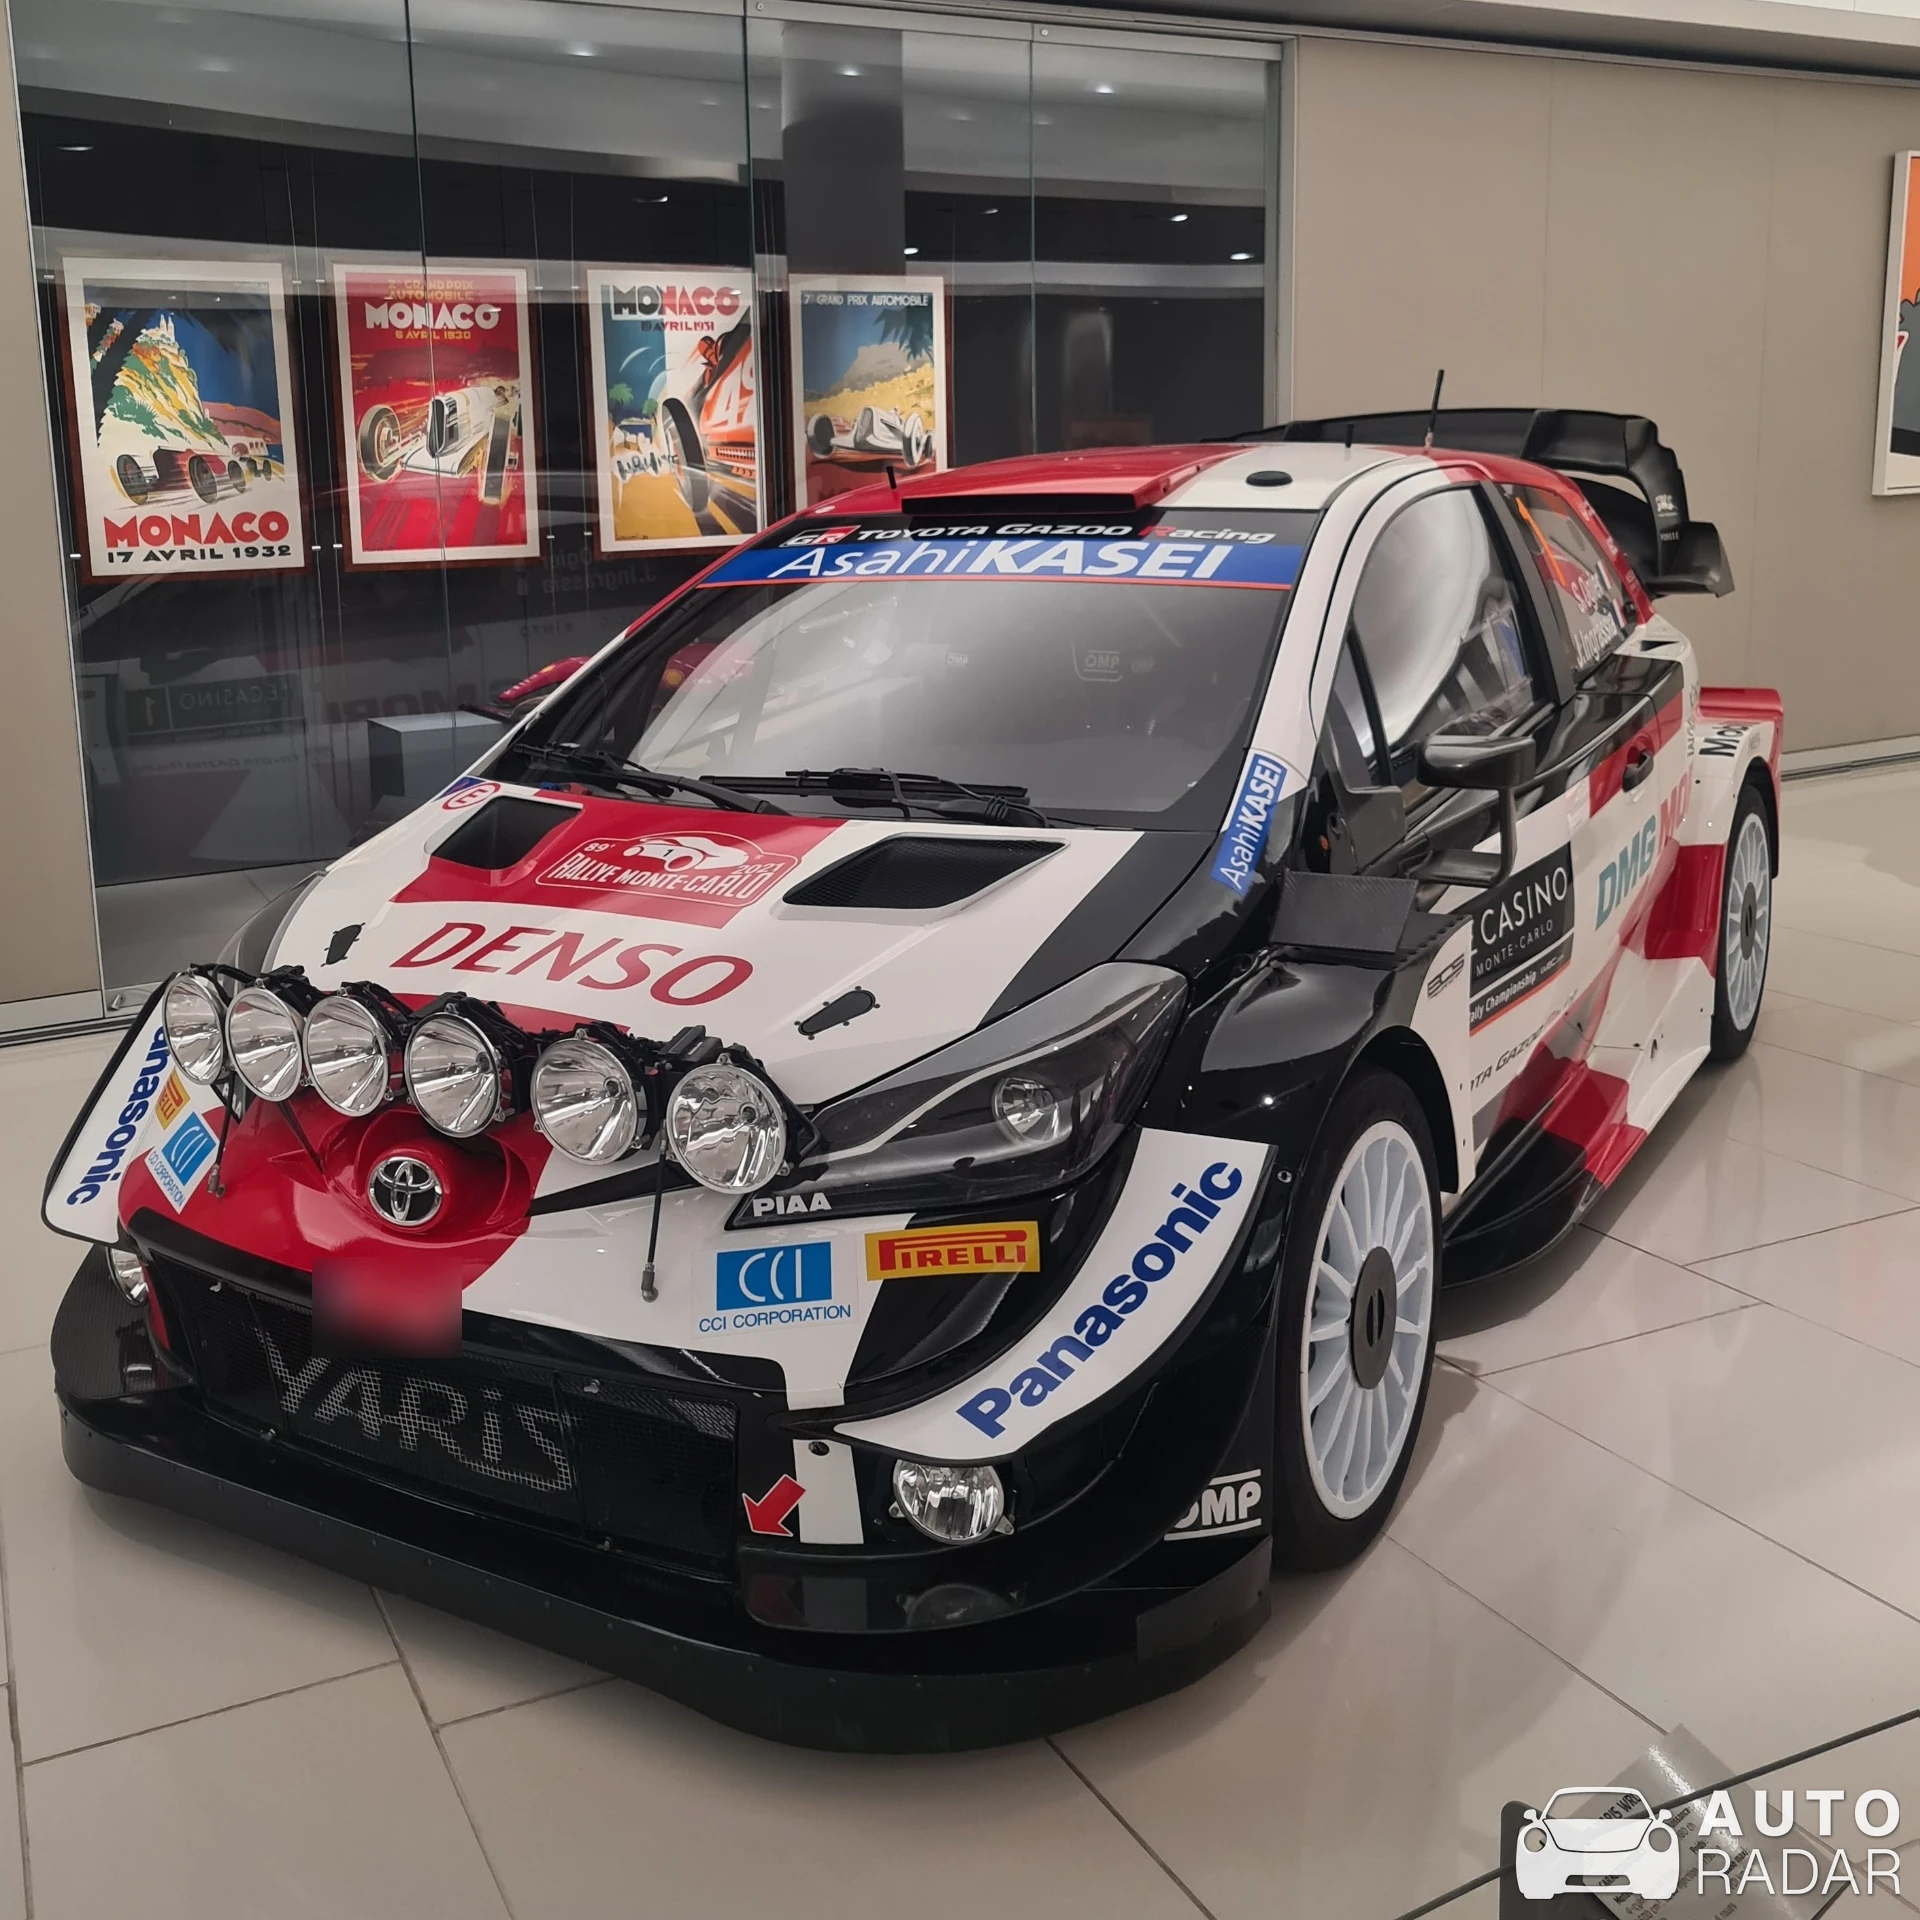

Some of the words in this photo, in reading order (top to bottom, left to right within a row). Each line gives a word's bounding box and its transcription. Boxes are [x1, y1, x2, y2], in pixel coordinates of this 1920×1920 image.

[388, 289, 474, 301] AUTOMOBILE
[404, 279, 445, 290] GRAND
[446, 280, 474, 291] PRIX
[613, 284, 741, 316] MONACO
[816, 294, 844, 306] GRAND
[847, 294, 869, 306] PRIX
[871, 295, 929, 307] AUTOMOBILE
[365, 302, 501, 330] MONACO
[406, 331, 440, 341] AVRIL
[103, 510, 290, 548] MONACO
[858, 524, 988, 542] TOYOTA
[995, 522, 1133, 538] GAZOO
[1139, 524, 1277, 546] Racing
[107, 550, 128, 563] 17
[142, 547, 224, 562] AVRIL
[233, 544, 292, 559] 1932
[1084, 654, 1121, 670] OMP
[546, 852, 622, 883] RALLYE
[737, 862, 784, 876] 2021
[1595, 814, 1657, 932] DMG
[1480, 863, 1569, 944] CASINO
[389, 921, 754, 1006] DENSO
[1469, 1001, 1486, 1025] ally
[1485, 969, 1538, 1014] Championship
[66, 1026, 170, 1206] anasonic
[752, 1191, 833, 1218] PIAA
[878, 1229, 1028, 1273] PIRELLI
[738, 1248, 804, 1303] CCI
[956, 1160, 1244, 1440] Panasonic
[698, 1315, 728, 1333] CCI
[732, 1303, 852, 1330] CORPORATION
